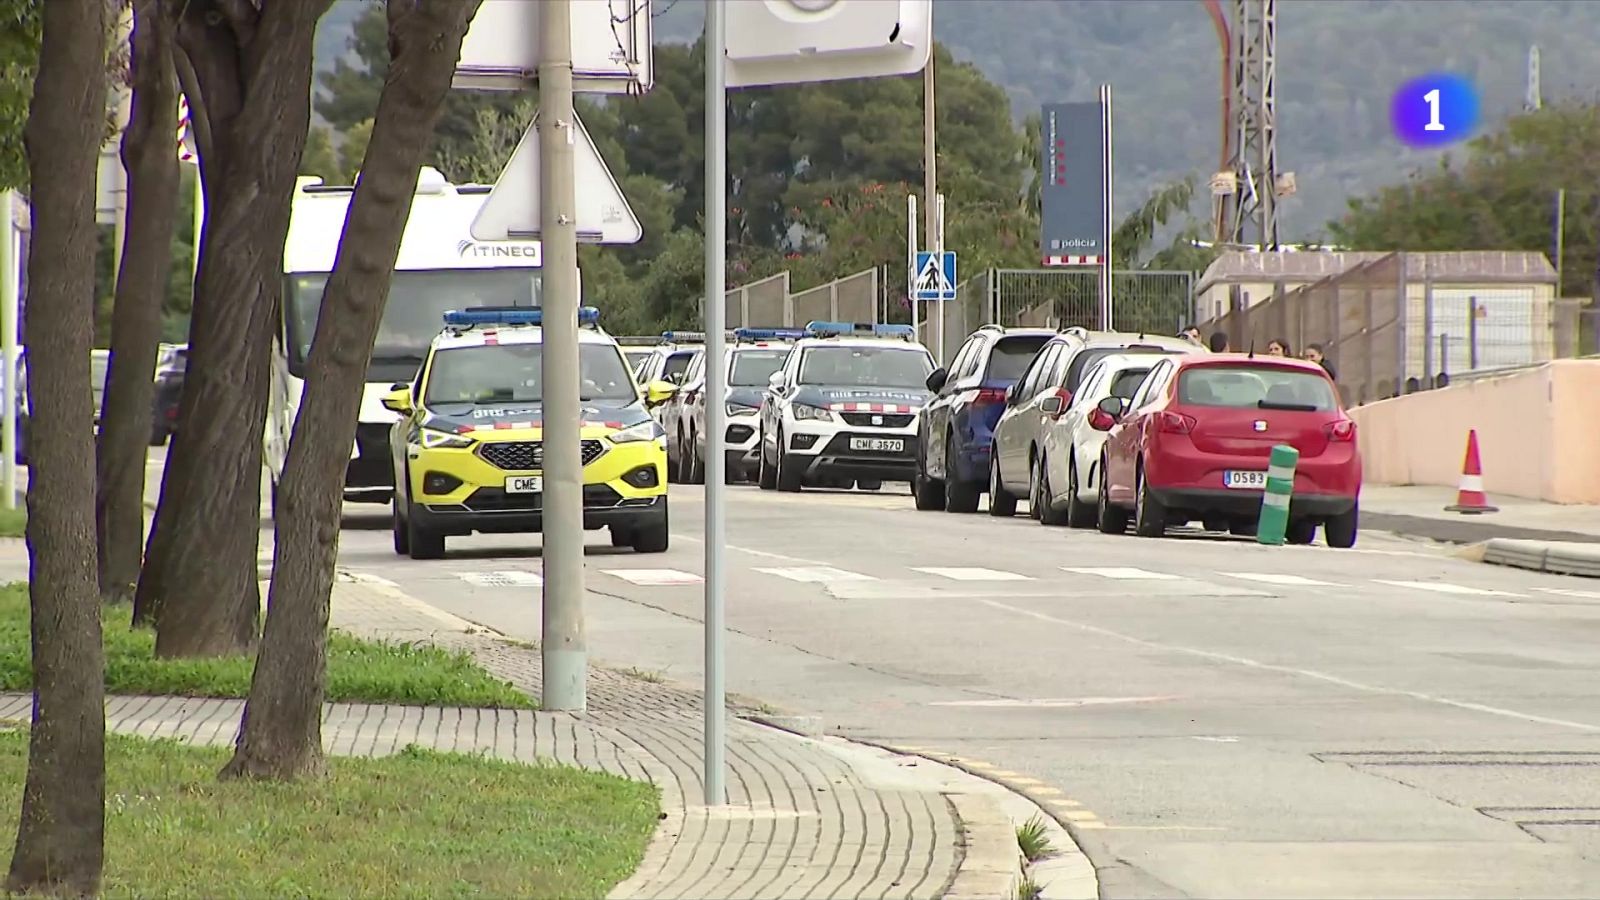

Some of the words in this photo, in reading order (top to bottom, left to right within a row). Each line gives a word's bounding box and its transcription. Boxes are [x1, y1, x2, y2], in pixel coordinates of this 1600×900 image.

[1061, 239, 1096, 249] policia
[473, 246, 536, 257] ITINEO
[1233, 472, 1264, 484] 0583
[514, 479, 538, 490] CME
